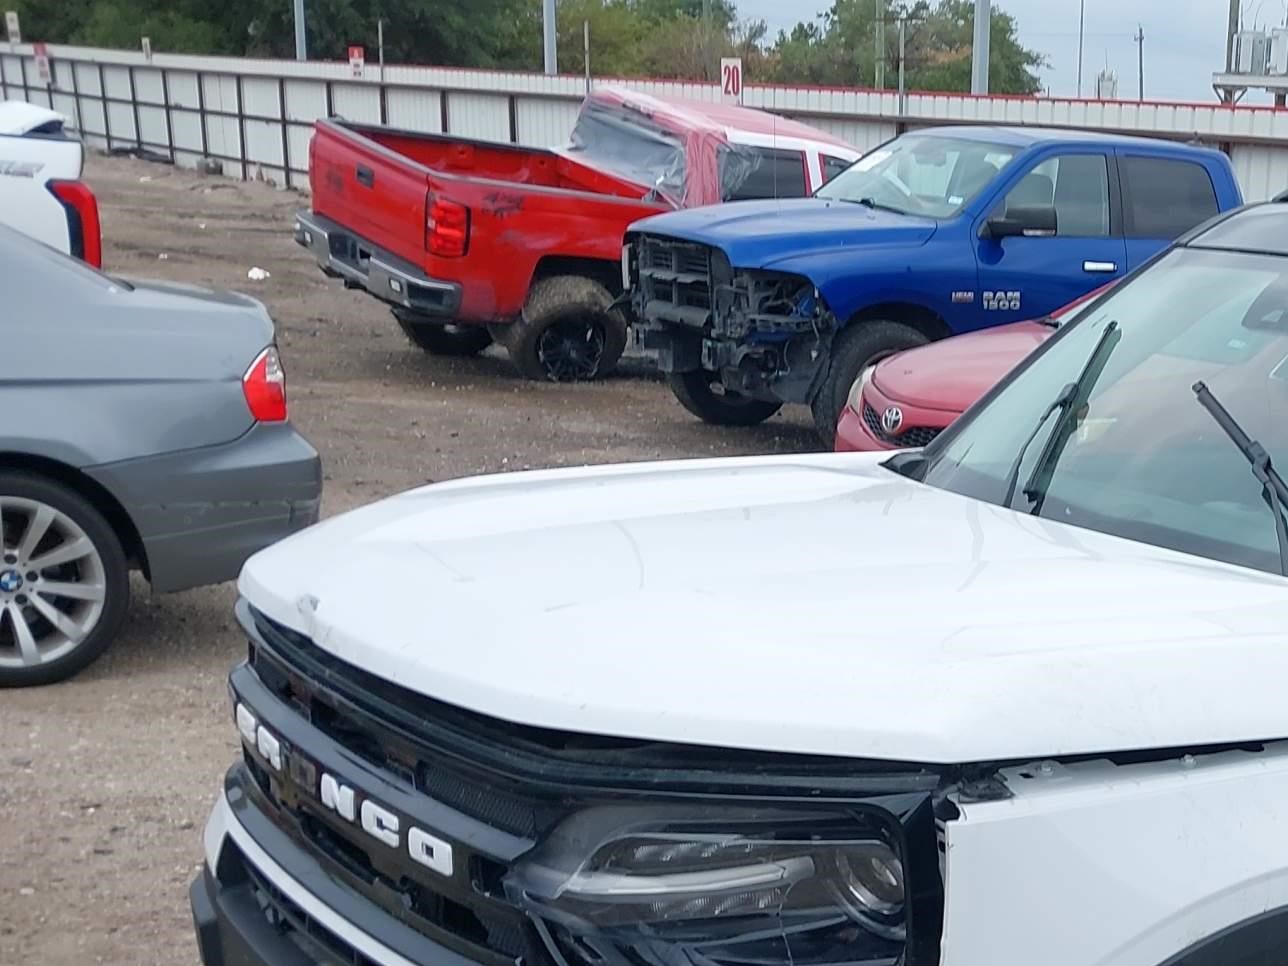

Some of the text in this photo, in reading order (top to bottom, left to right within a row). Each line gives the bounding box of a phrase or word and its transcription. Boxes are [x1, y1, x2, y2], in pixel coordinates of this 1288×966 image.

[724, 65, 740, 96] 20
[983, 291, 1020, 301] RAM
[983, 301, 1020, 310] 1500
